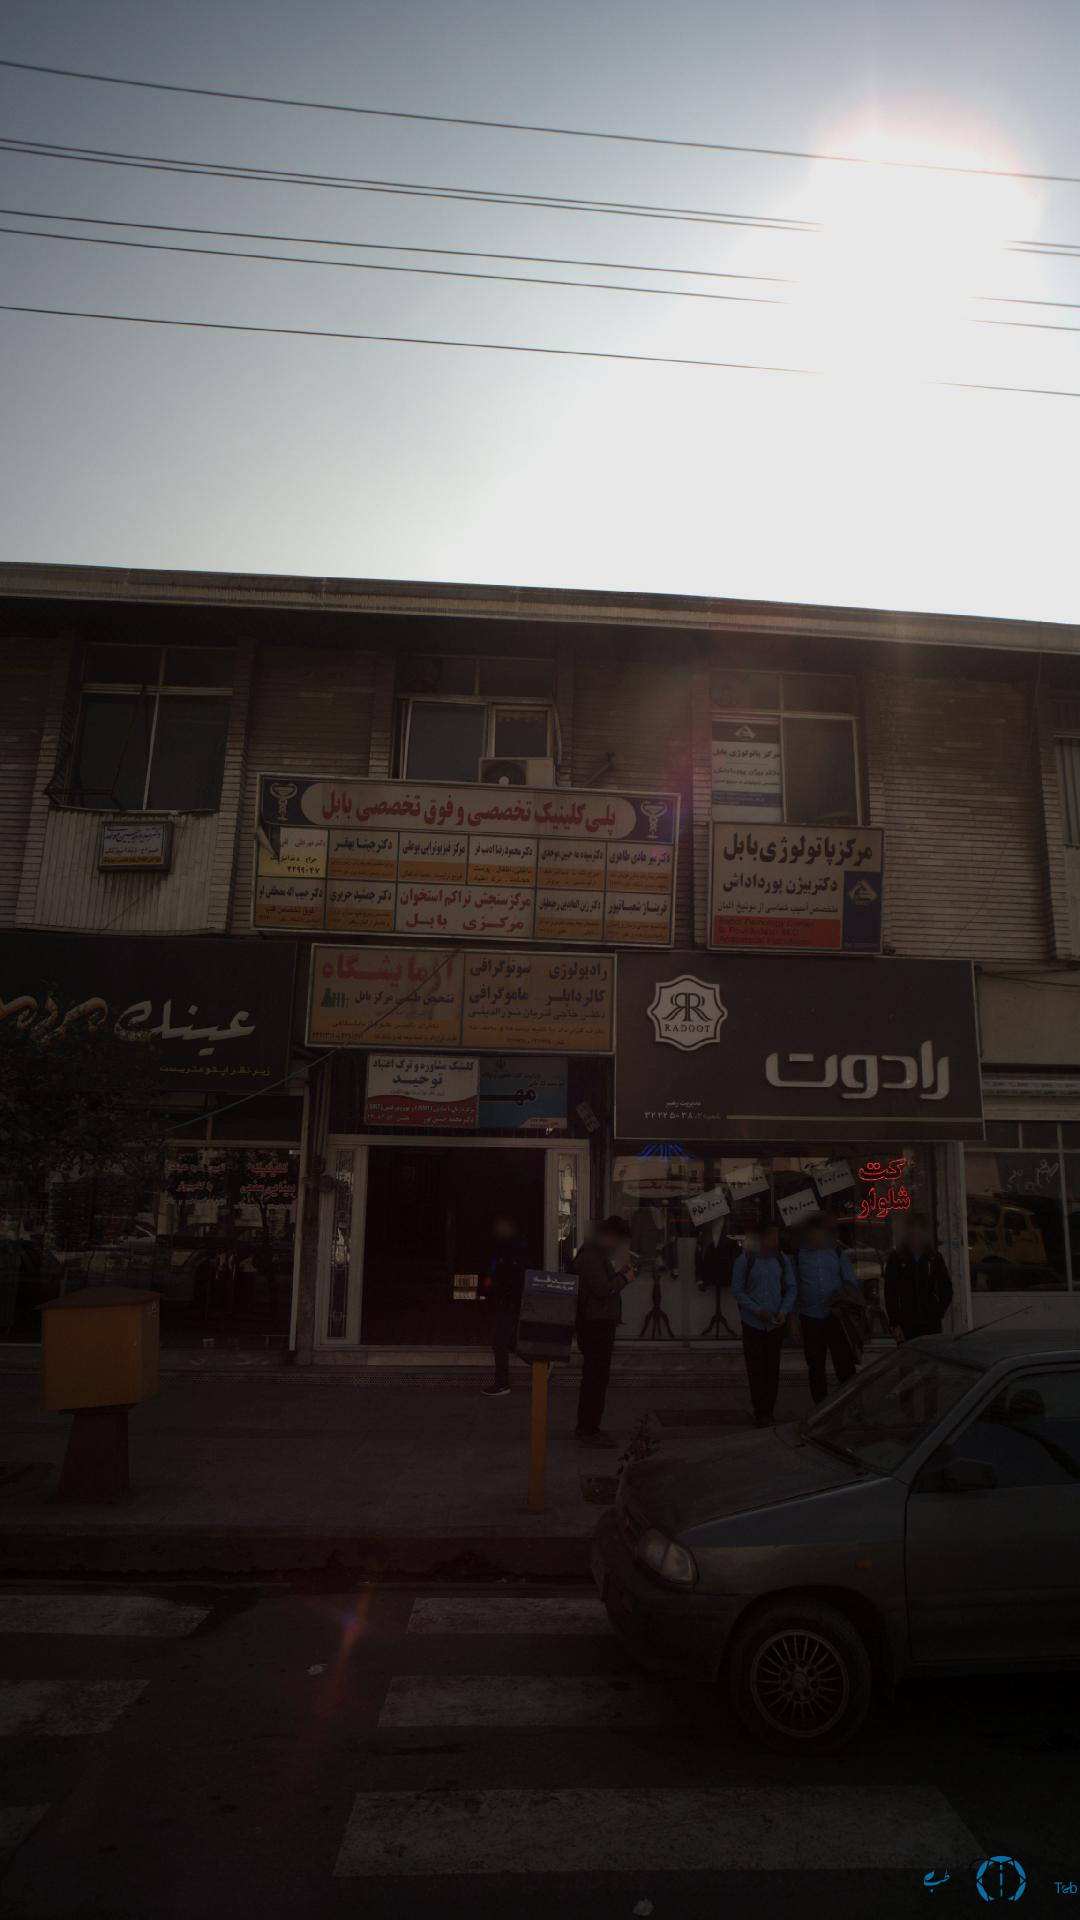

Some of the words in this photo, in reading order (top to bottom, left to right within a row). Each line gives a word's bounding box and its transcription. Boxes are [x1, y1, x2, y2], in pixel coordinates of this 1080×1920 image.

[322, 791, 353, 820] بابل
[356, 794, 421, 822] تخصصی
[424, 795, 454, 826] فوق
[456, 806, 465, 826] و
[468, 800, 532, 827] تخصصی
[586, 803, 615, 836] پلی
[376, 838, 393, 853] دکتر
[723, 831, 759, 862] بابل
[759, 836, 833, 865] پاتولوژی
[835, 838, 873, 867] مرکز
[723, 873, 782, 895] پورداداش
[786, 878, 812, 895] بیژن
[812, 876, 839, 895] دکتر
[377, 889, 392, 904] دکتر
[400, 887, 443, 906] استخوان
[444, 888, 472, 909] تراکم
[474, 891, 508, 909] سنجش
[508, 892, 532, 911] مرکز
[405, 912, 447, 929] بابل
[463, 915, 524, 932] مرکزی
[470, 957, 531, 978] سونوگرافی
[550, 961, 608, 981] رادیولوژی
[354, 990, 371, 1004] بابل
[374, 991, 393, 1005] مرکز
[469, 983, 529, 1006] ماموگرافی
[114, 999, 256, 1057] عینک
[665, 1023, 711, 1033] RADOOT
[765, 1039, 950, 1100] رادوت
[392, 1072, 443, 1089] توحید
[859, 1158, 907, 1182] کت
[857, 1186, 911, 1219] شلوار
